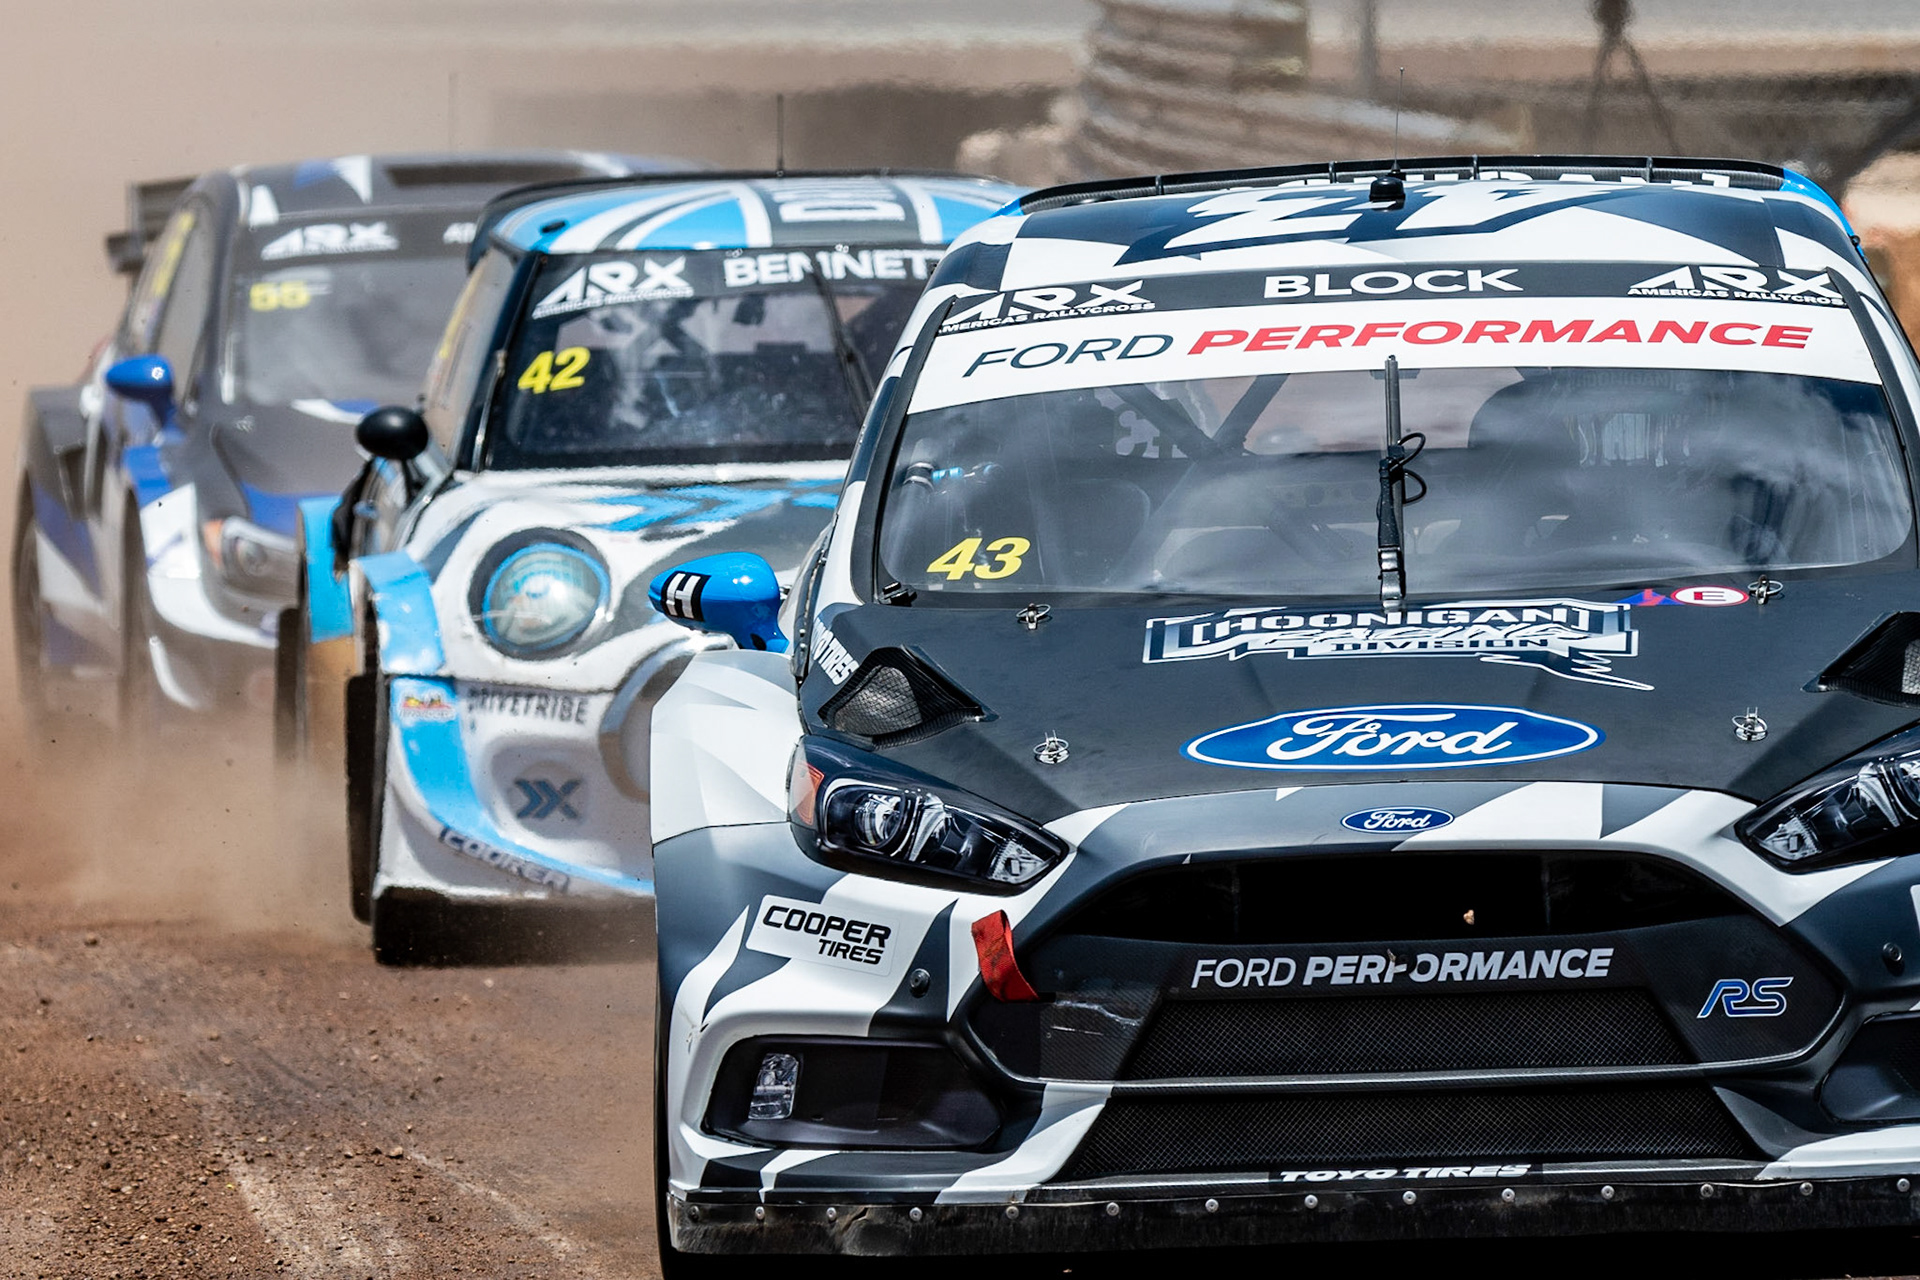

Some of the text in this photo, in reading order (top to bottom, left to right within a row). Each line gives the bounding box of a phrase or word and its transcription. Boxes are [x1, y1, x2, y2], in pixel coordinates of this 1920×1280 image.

[261, 222, 398, 256] ARX
[534, 256, 690, 306] ARX
[1263, 267, 1524, 299] BLOCK
[1627, 288, 1848, 306] AMERICAS RALLYCROS
[1630, 265, 1844, 299] ARX
[938, 302, 1156, 334] MERICAS RALLYCROSS
[943, 280, 1152, 326] ARX
[962, 318, 1814, 378] FORD PERFORMANCE
[517, 346, 592, 394] 42
[926, 536, 1031, 580] 43
[818, 638, 860, 686] TIRES
[1330, 638, 1549, 652] DIVISION
[1266, 713, 1520, 761] Ford
[1363, 809, 1434, 830] Ford
[763, 905, 892, 948] COOPER
[818, 939, 884, 965] TIRES
[1191, 957, 1297, 988] FORD
[1697, 976, 1794, 1018] RS
[1280, 1163, 1532, 1182] TOYO TIRES
